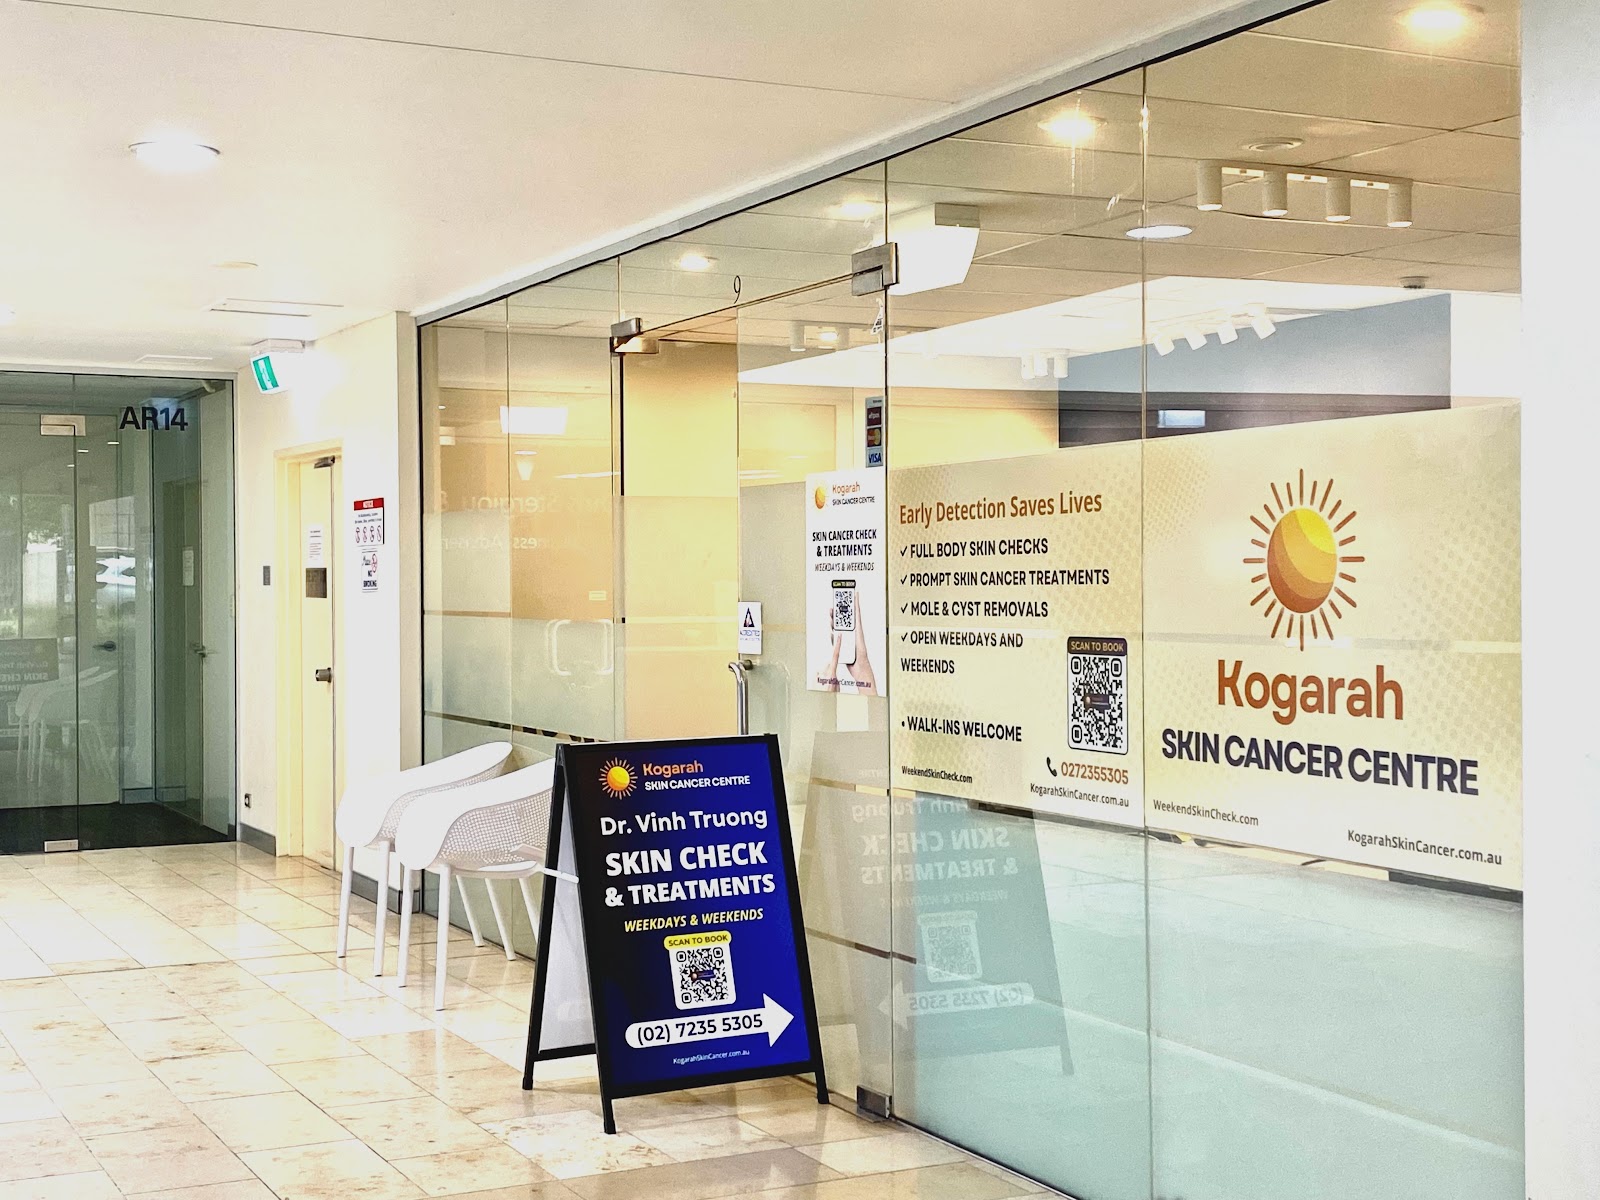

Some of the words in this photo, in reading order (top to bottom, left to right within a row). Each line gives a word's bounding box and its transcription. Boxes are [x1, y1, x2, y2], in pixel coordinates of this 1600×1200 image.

[733, 275, 741, 304] 9
[119, 406, 188, 431] AR14
[868, 452, 882, 464] VISA
[832, 481, 860, 496] Kogarah
[832, 498, 842, 506] SKIN
[842, 497, 859, 505] CANCER
[859, 496, 876, 504] CENTRE
[900, 502, 932, 529] Early
[936, 497, 1006, 522] Detection
[1010, 495, 1055, 518] Saves
[1060, 490, 1102, 514] Lives
[812, 531, 827, 542] SKIN
[828, 529, 854, 541] CANCER
[855, 528, 877, 540] CHECK
[816, 545, 822, 557] &
[823, 543, 873, 557] TREATMENTS
[910, 543, 934, 558] FULL
[936, 541, 967, 557] BODY
[969, 540, 996, 556] SKIN
[999, 537, 1048, 555] CHECKS
[815, 562, 840, 572] WEEKDAYS
[846, 561, 875, 571] WEEKENDS
[910, 572, 951, 587] PROMPT
[953, 571, 978, 586] SKIN
[980, 570, 1026, 586] CANCER
[1028, 568, 1110, 585] TREATMENTS
[911, 601, 940, 616] MOLE
[942, 601, 949, 616] &
[951, 601, 981, 616] CYST
[984, 601, 1049, 617] REMOVALS
[910, 630, 937, 645] OPEN
[938, 631, 997, 647] WEEKDAYS
[999, 633, 1024, 648] AND
[1070, 641, 1090, 651] SCAN
[1091, 642, 1101, 651] TO
[1102, 642, 1124, 652] BOOK
[900, 657, 955, 674] WEEKENDS
[1217, 659, 1404, 725] Kogarah
[907, 715, 960, 736] WALK-INS
[962, 722, 1023, 742] WELCOME
[642, 760, 704, 778] Kogarah
[1161, 727, 1219, 764] SKIN
[1224, 734, 1343, 780] CANCER
[1347, 747, 1479, 796] CENTRE
[644, 780, 668, 791] SKIN
[667, 777, 711, 789] CANCER
[711, 775, 751, 786] CENTRE
[901, 765, 973, 784] WeekendSkinCheck.com
[1061, 761, 1129, 785] 0272355305
[1030, 783, 1129, 808] KogarahSkinCancer.com.au
[600, 816, 632, 835] Dr.
[635, 811, 686, 833] Vinh
[689, 809, 767, 830] Truong
[1153, 799, 1259, 827] WeekendSkinCheck.com
[1347, 829, 1503, 866] KogarahSkinCancer.com.au
[605, 848, 673, 877] SKIN
[679, 841, 768, 870] CHECK
[604, 886, 624, 907] &
[627, 873, 776, 905] TREATMENTS
[624, 915, 687, 933] WEEKDAYS
[690, 914, 699, 926] &
[701, 908, 764, 925] WEEKENDS
[668, 938, 690, 947] SCAN
[692, 936, 703, 945] TO
[705, 934, 728, 943] BOOK
[637, 1024, 670, 1046] (02)
[675, 1019, 717, 1037] 7235
[722, 1014, 763, 1032] 5305
[673, 1049, 750, 1065] KogarahSkinCancer.com.au
